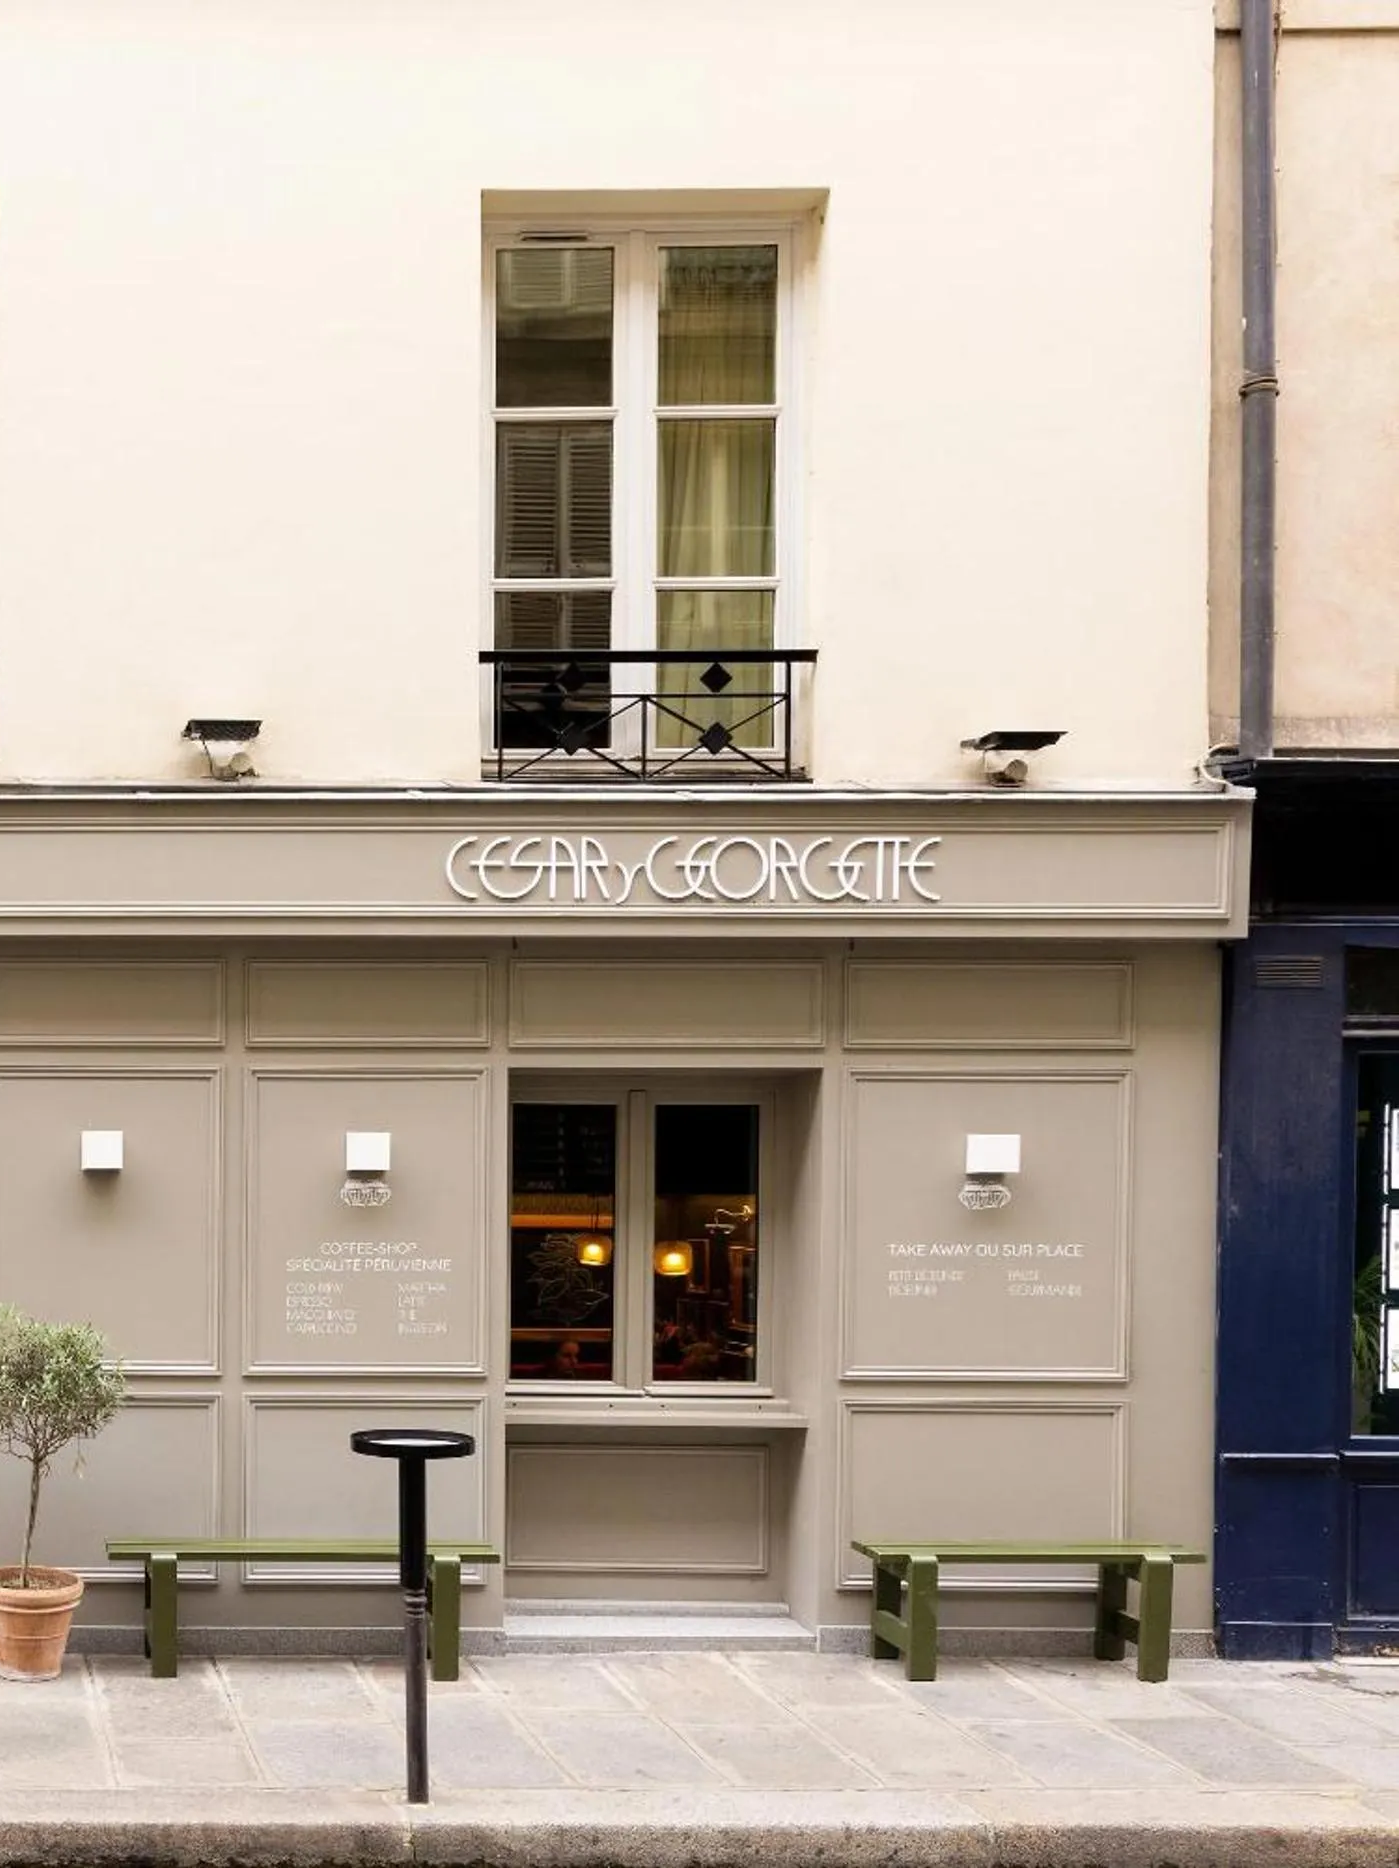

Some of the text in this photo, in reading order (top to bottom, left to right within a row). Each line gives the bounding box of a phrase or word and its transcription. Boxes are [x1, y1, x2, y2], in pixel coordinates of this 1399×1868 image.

[888, 1243, 927, 1256] TAKE
[929, 1243, 972, 1256] AWAY
[976, 1243, 999, 1257] OU
[1037, 1243, 1085, 1257] PLACE
